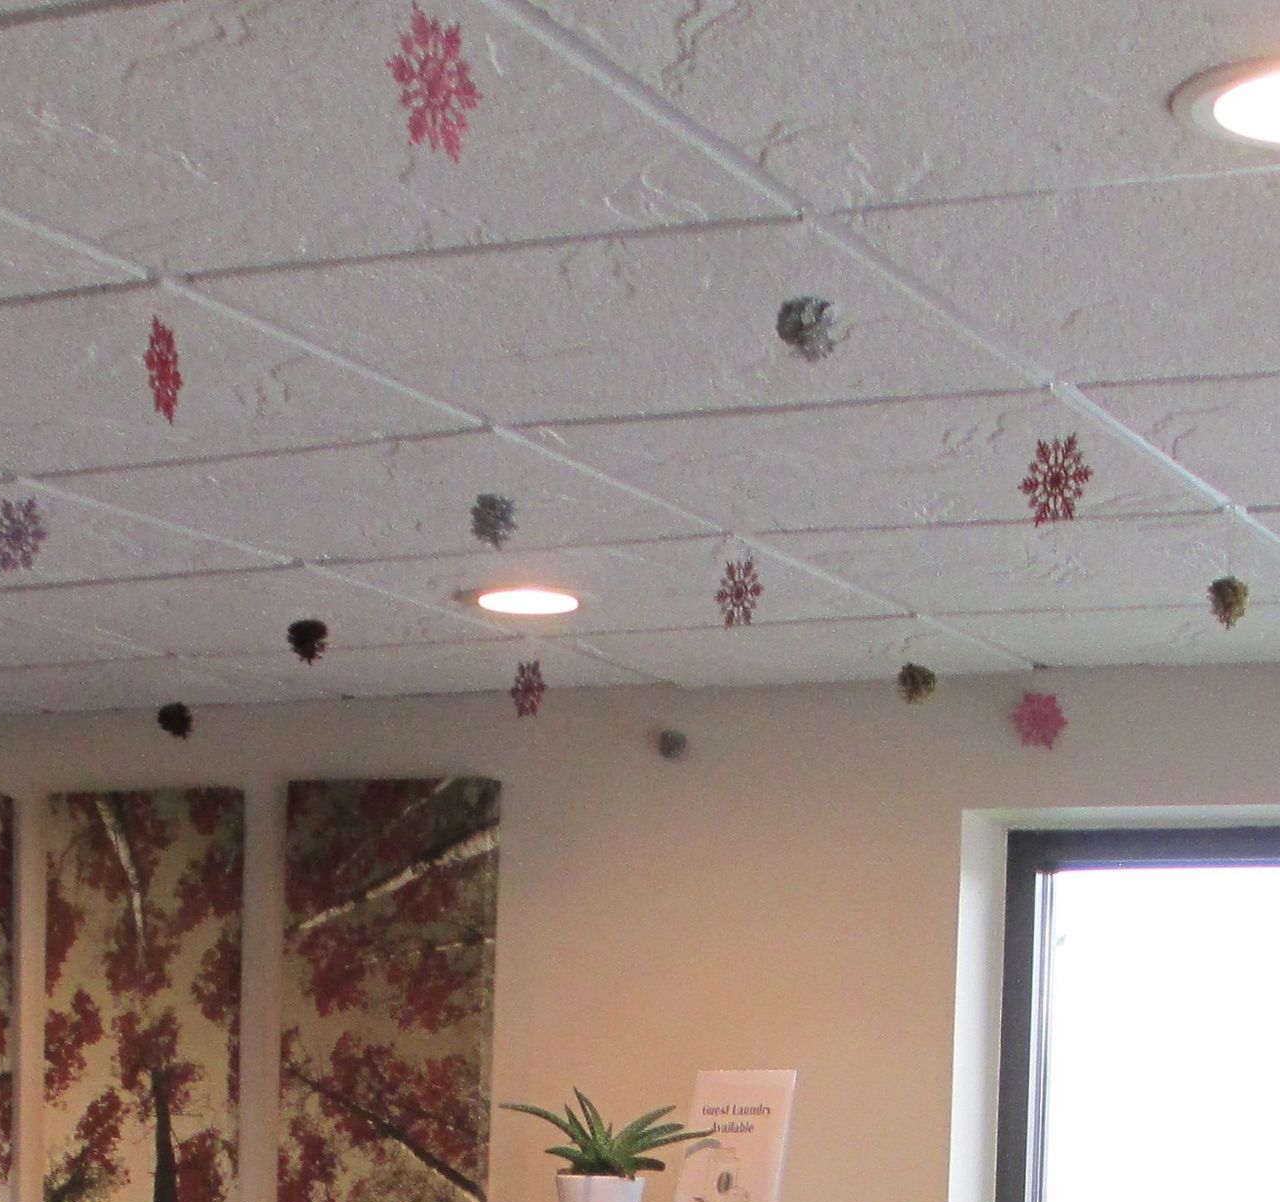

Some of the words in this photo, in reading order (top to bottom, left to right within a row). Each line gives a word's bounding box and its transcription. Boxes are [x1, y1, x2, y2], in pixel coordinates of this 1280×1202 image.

[702, 1105, 729, 1116] Guest
[732, 1104, 771, 1117] Laundry
[713, 1121, 754, 1133] Available
